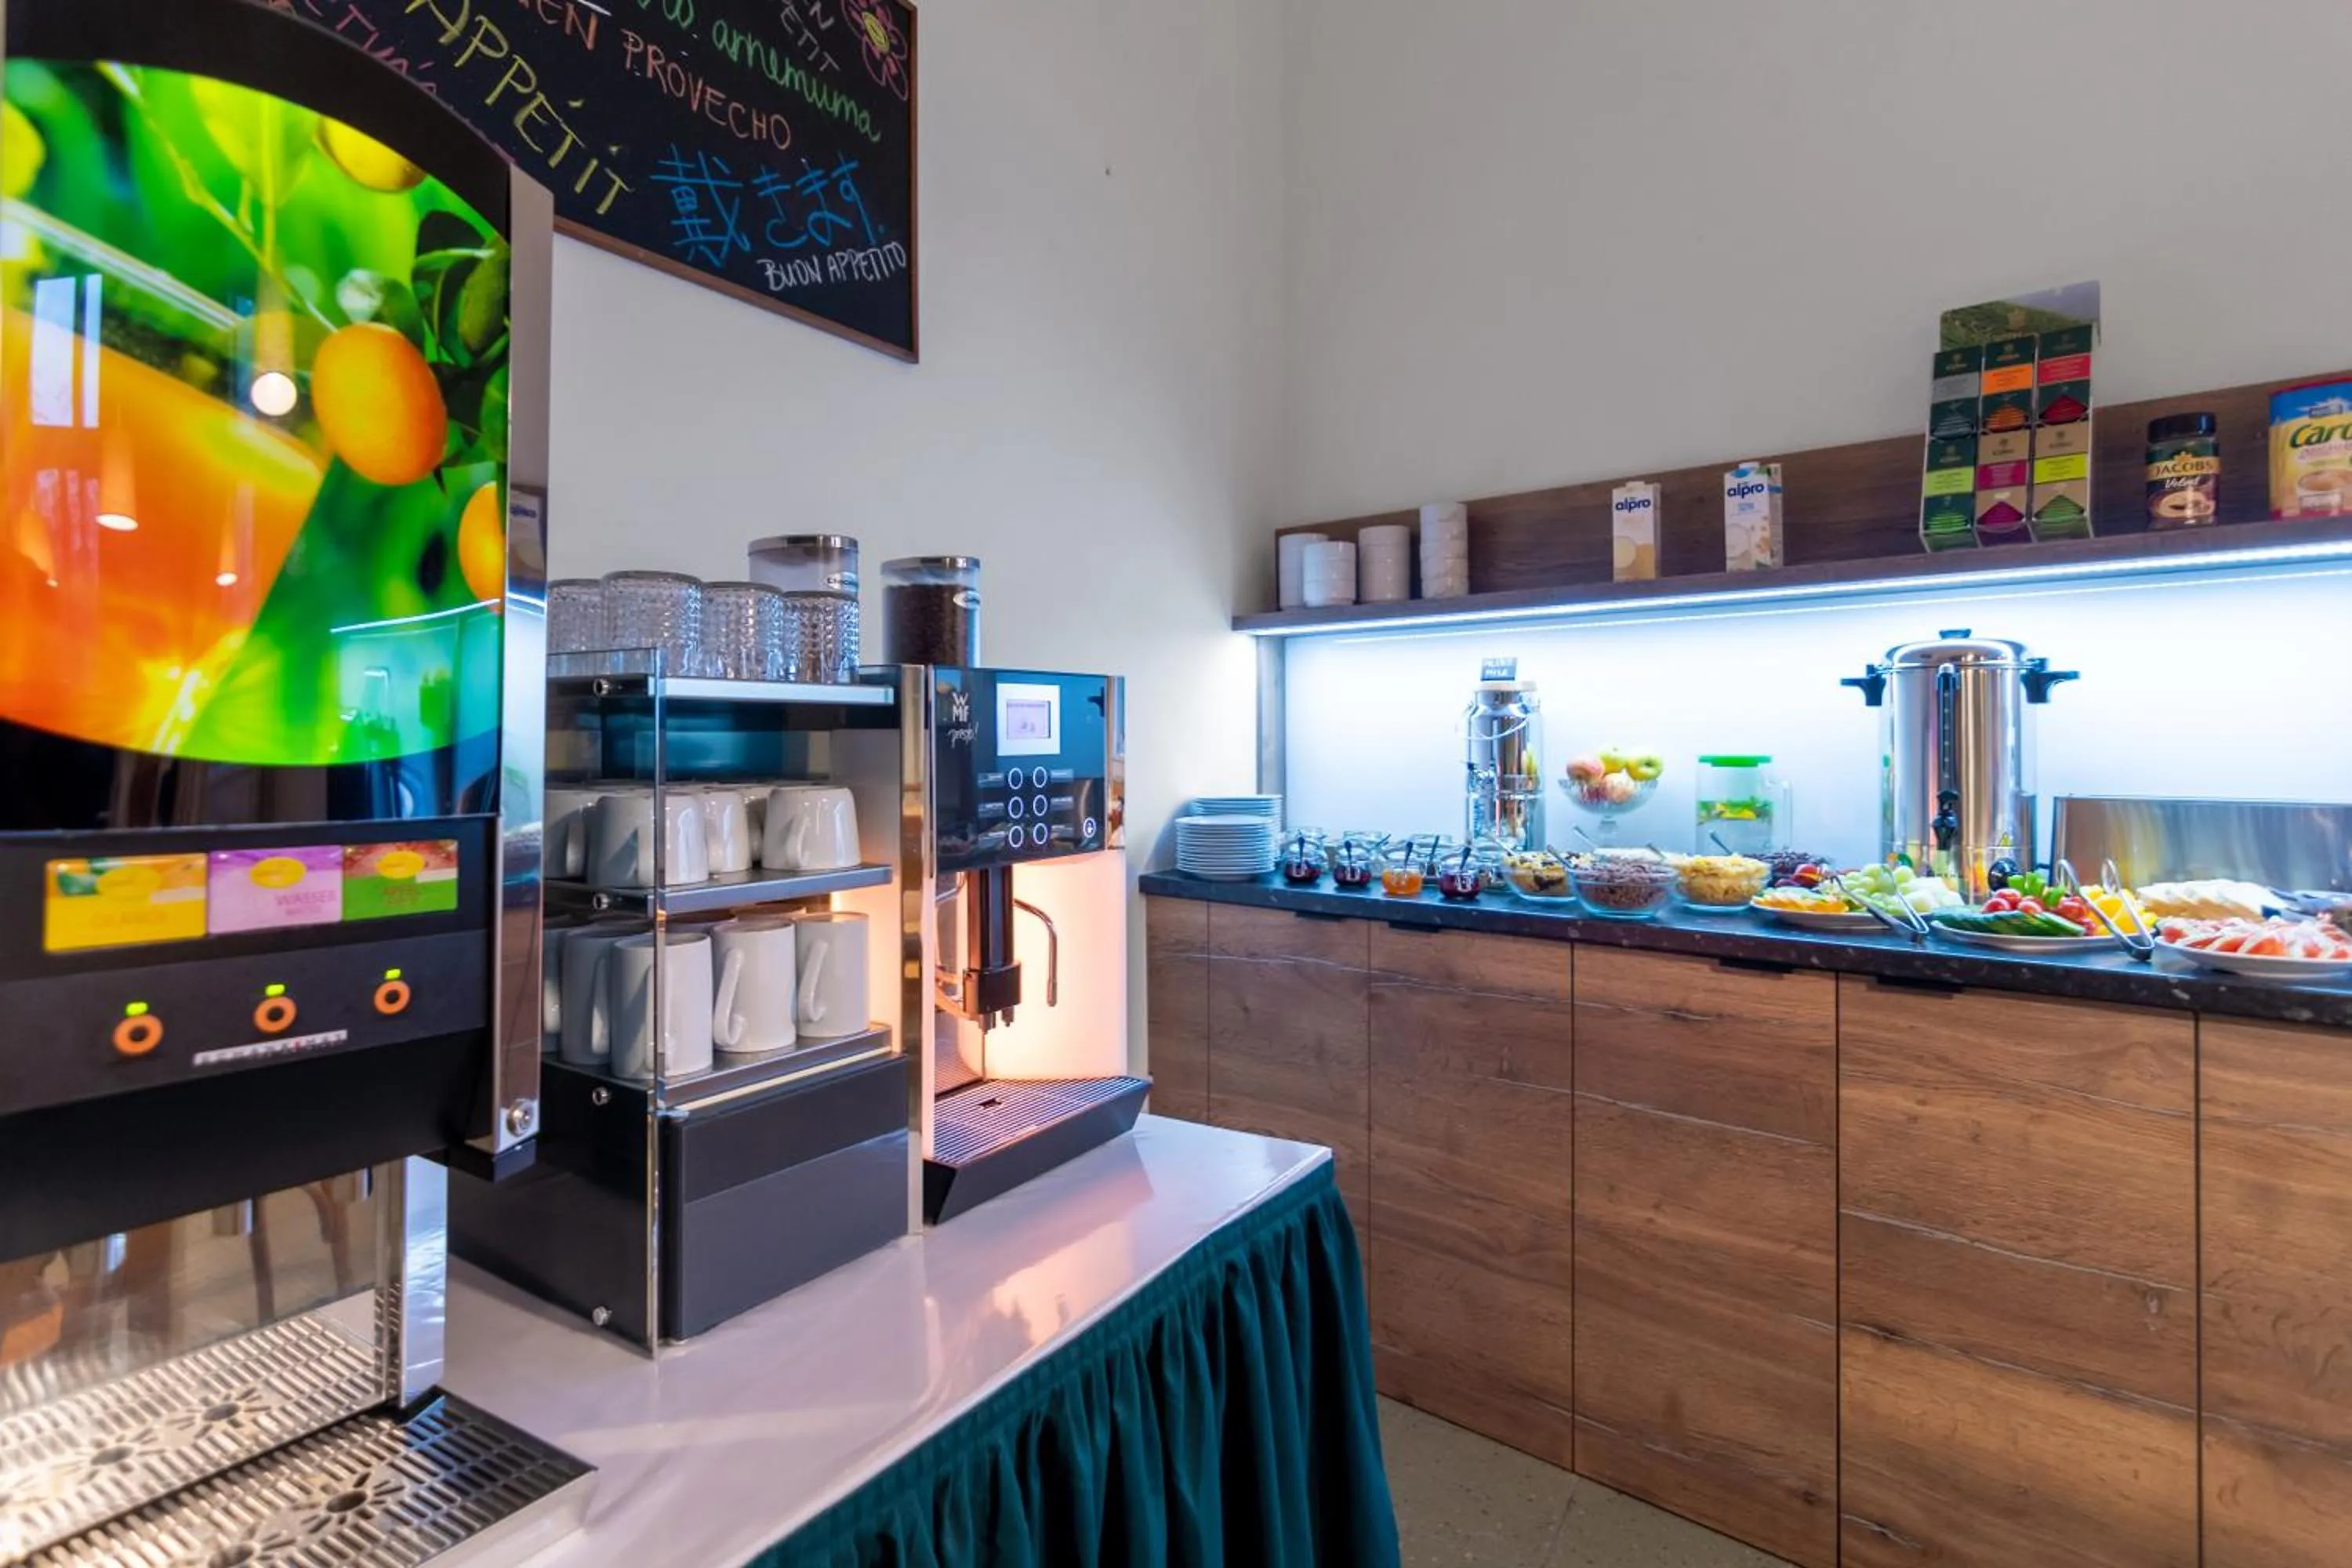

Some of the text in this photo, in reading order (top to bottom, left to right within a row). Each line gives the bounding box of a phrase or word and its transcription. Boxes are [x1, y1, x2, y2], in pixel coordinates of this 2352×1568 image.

[620, 28, 792, 150] PROVECHO
[757, 241, 907, 292] BUON APPETITO
[2156, 459, 2212, 477] JACOBS
[1726, 481, 1765, 499] alpro
[1615, 496, 1651, 513] alpro
